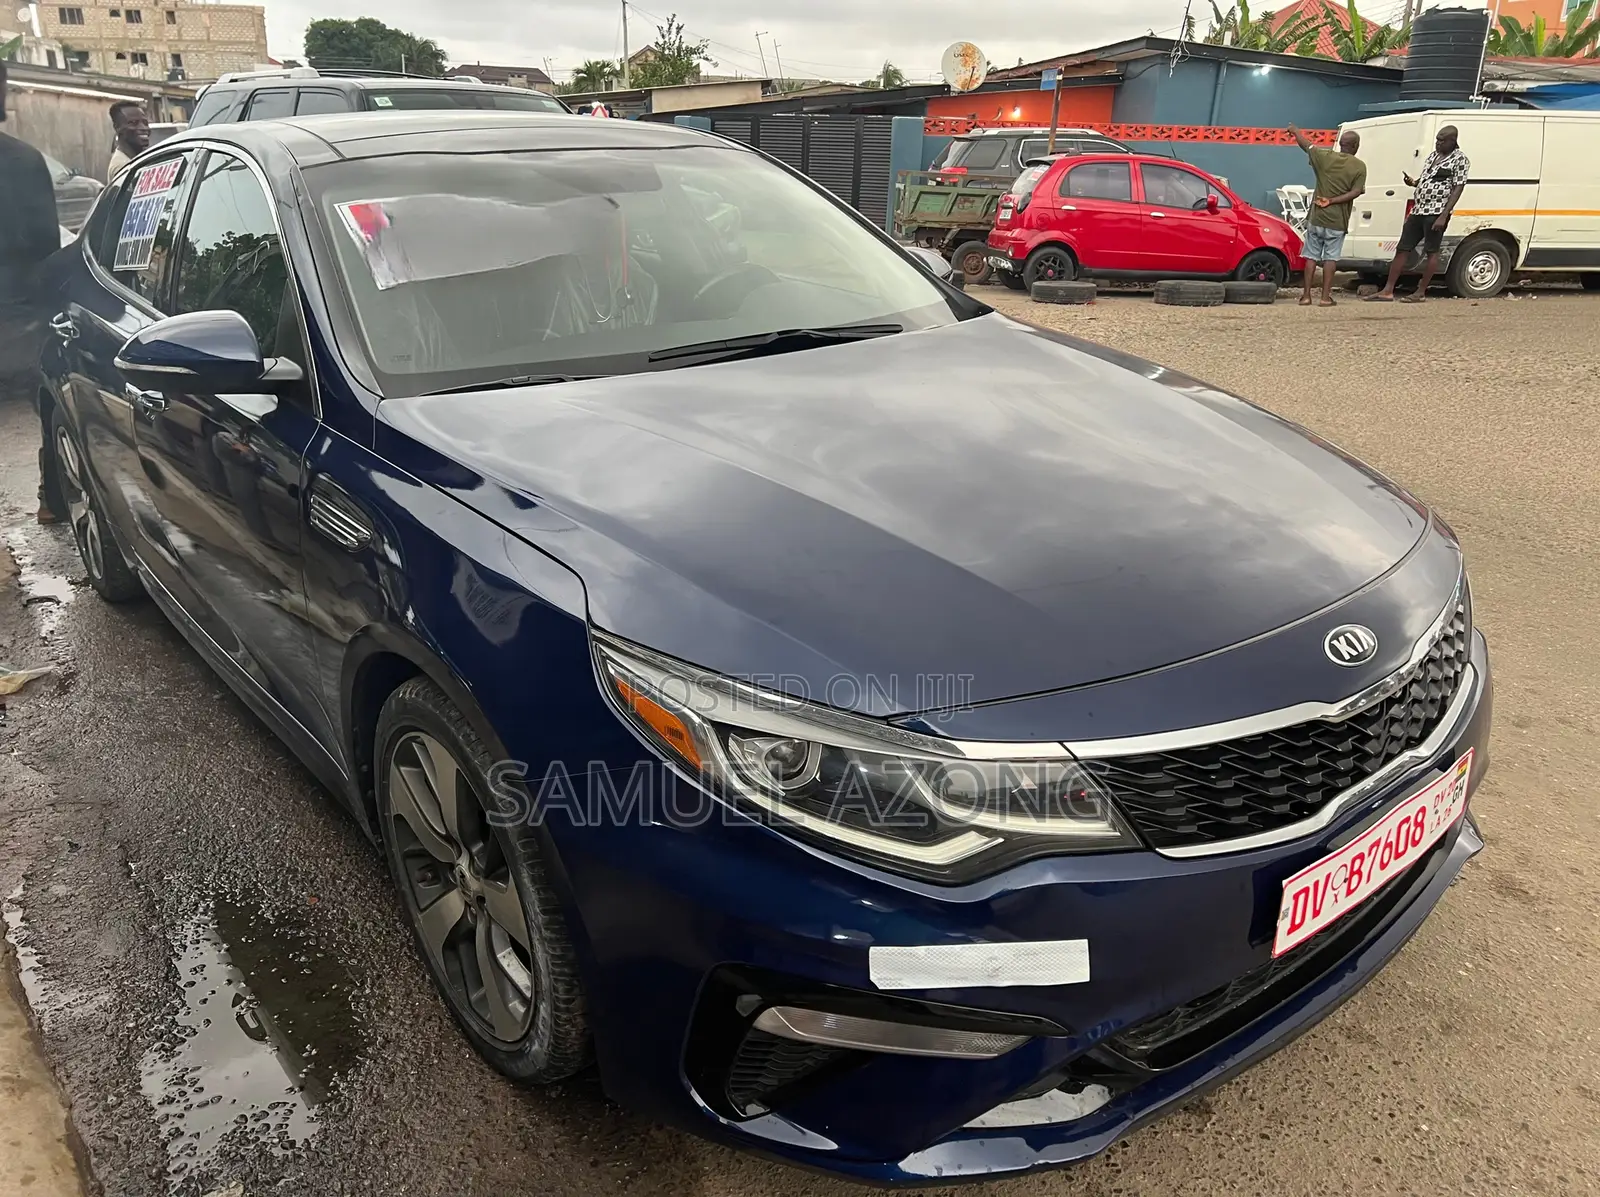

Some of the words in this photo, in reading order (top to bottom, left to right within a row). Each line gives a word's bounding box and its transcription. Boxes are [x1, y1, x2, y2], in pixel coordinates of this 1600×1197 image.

[136, 167, 157, 196] FOR
[151, 160, 182, 190] SALE
[1330, 629, 1375, 660] KIA
[1286, 871, 1332, 937] DV
